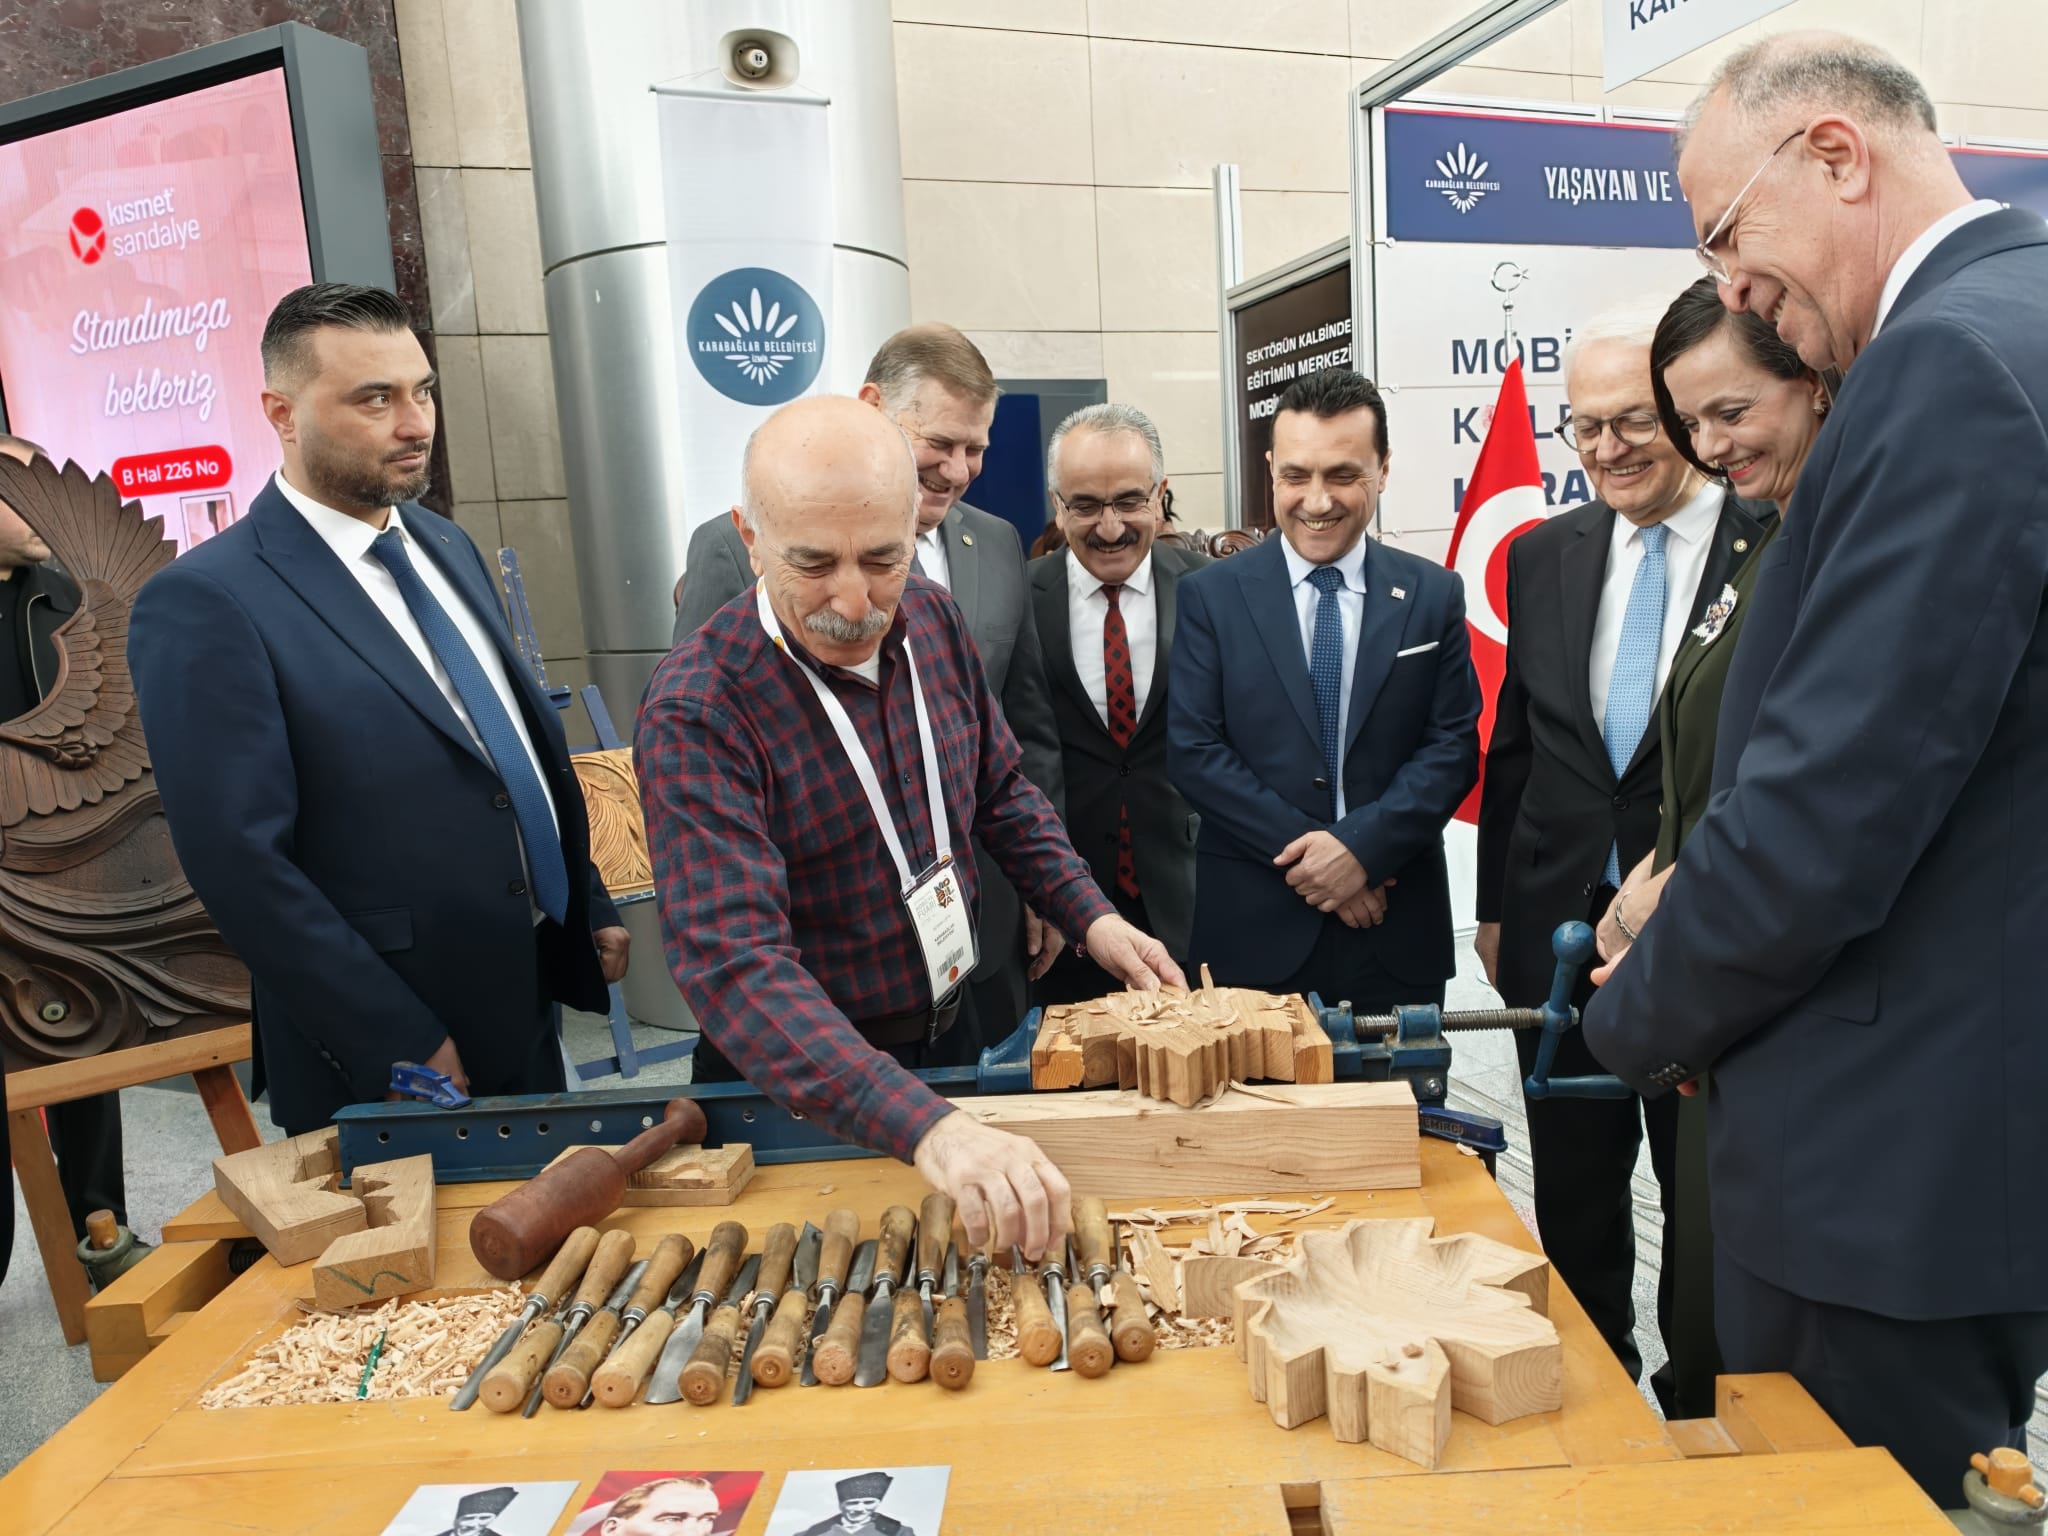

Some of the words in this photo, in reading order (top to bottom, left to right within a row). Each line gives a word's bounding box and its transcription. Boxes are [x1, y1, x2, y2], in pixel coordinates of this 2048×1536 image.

[1544, 166, 1639, 206] YAŞAYAN
[1644, 170, 1673, 202] VE
[107, 187, 174, 227] kısmet
[113, 217, 201, 257] sandalye
[70, 297, 231, 354] Standımıza
[1246, 334, 1297, 365] SEKTÖRÜN
[1299, 318, 1352, 349] KALBİNDE
[698, 339, 761, 352] KARABAĞLAR
[764, 339, 817, 353] BELEDİYESİ
[1247, 362, 1295, 391] EĞİTİMİN
[1298, 342, 1353, 376] MERKEZİ
[105, 367, 216, 422] bekleriz
[122, 469, 135, 486] B
[137, 464, 162, 484] Hal
[164, 461, 193, 480] 226
[196, 458, 219, 476] No
